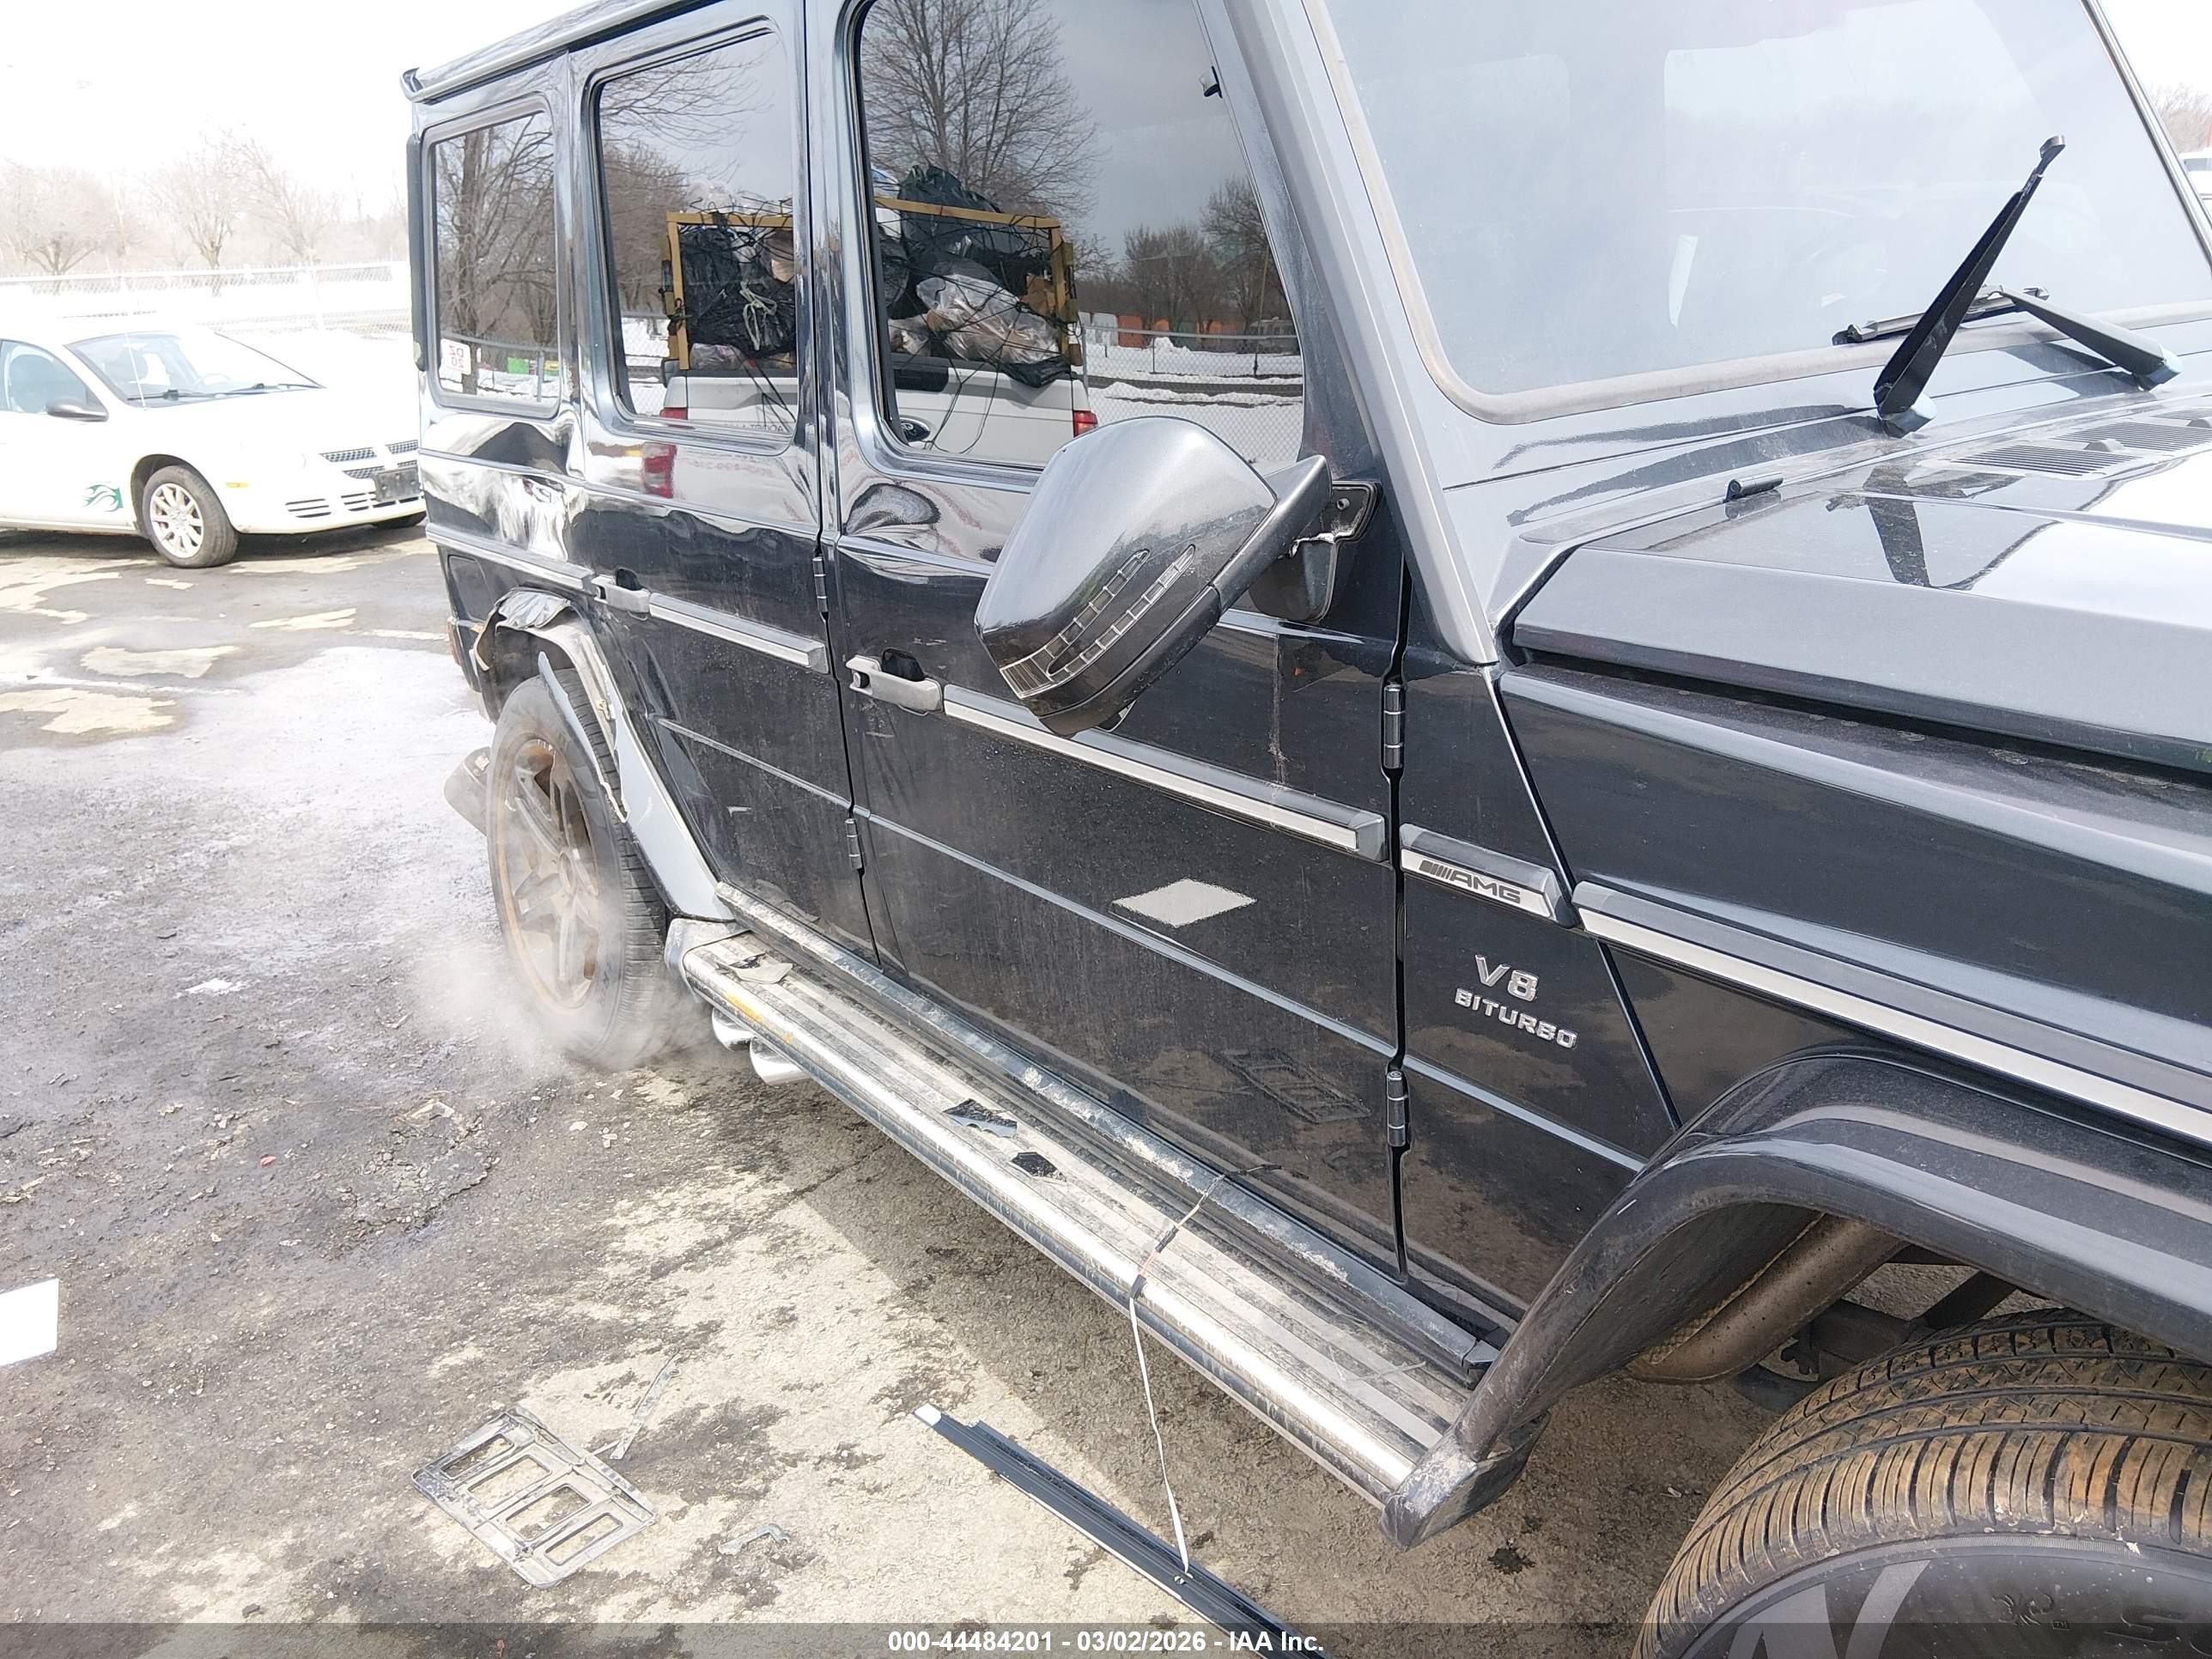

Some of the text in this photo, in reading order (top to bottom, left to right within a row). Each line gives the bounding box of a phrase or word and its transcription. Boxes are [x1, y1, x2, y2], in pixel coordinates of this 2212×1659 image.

[1449, 870, 1521, 904] AMG
[1474, 953, 1540, 1003] V8
[1453, 987, 1580, 1049] BITURBO
